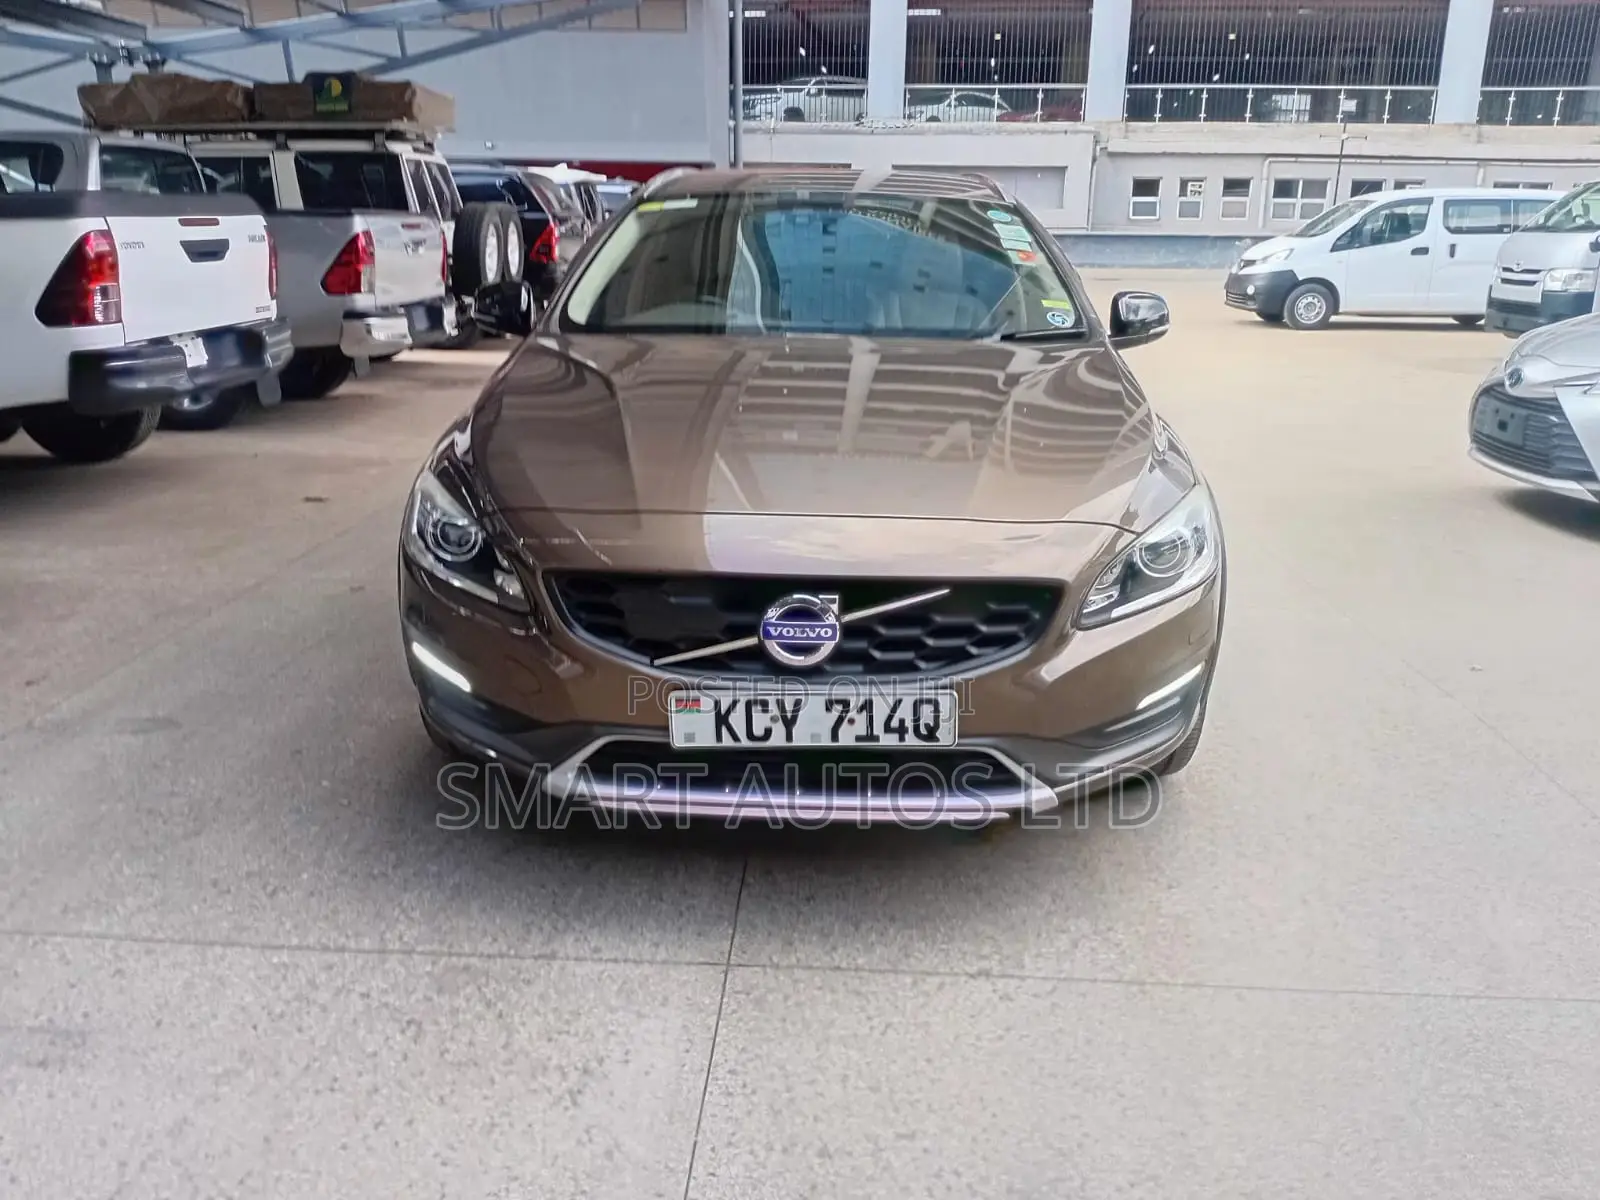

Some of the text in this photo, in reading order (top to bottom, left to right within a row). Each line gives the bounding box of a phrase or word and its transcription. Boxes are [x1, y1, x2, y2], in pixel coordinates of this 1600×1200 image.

[767, 626, 832, 639] VOLVO
[714, 698, 941, 743] KCY 714Q
